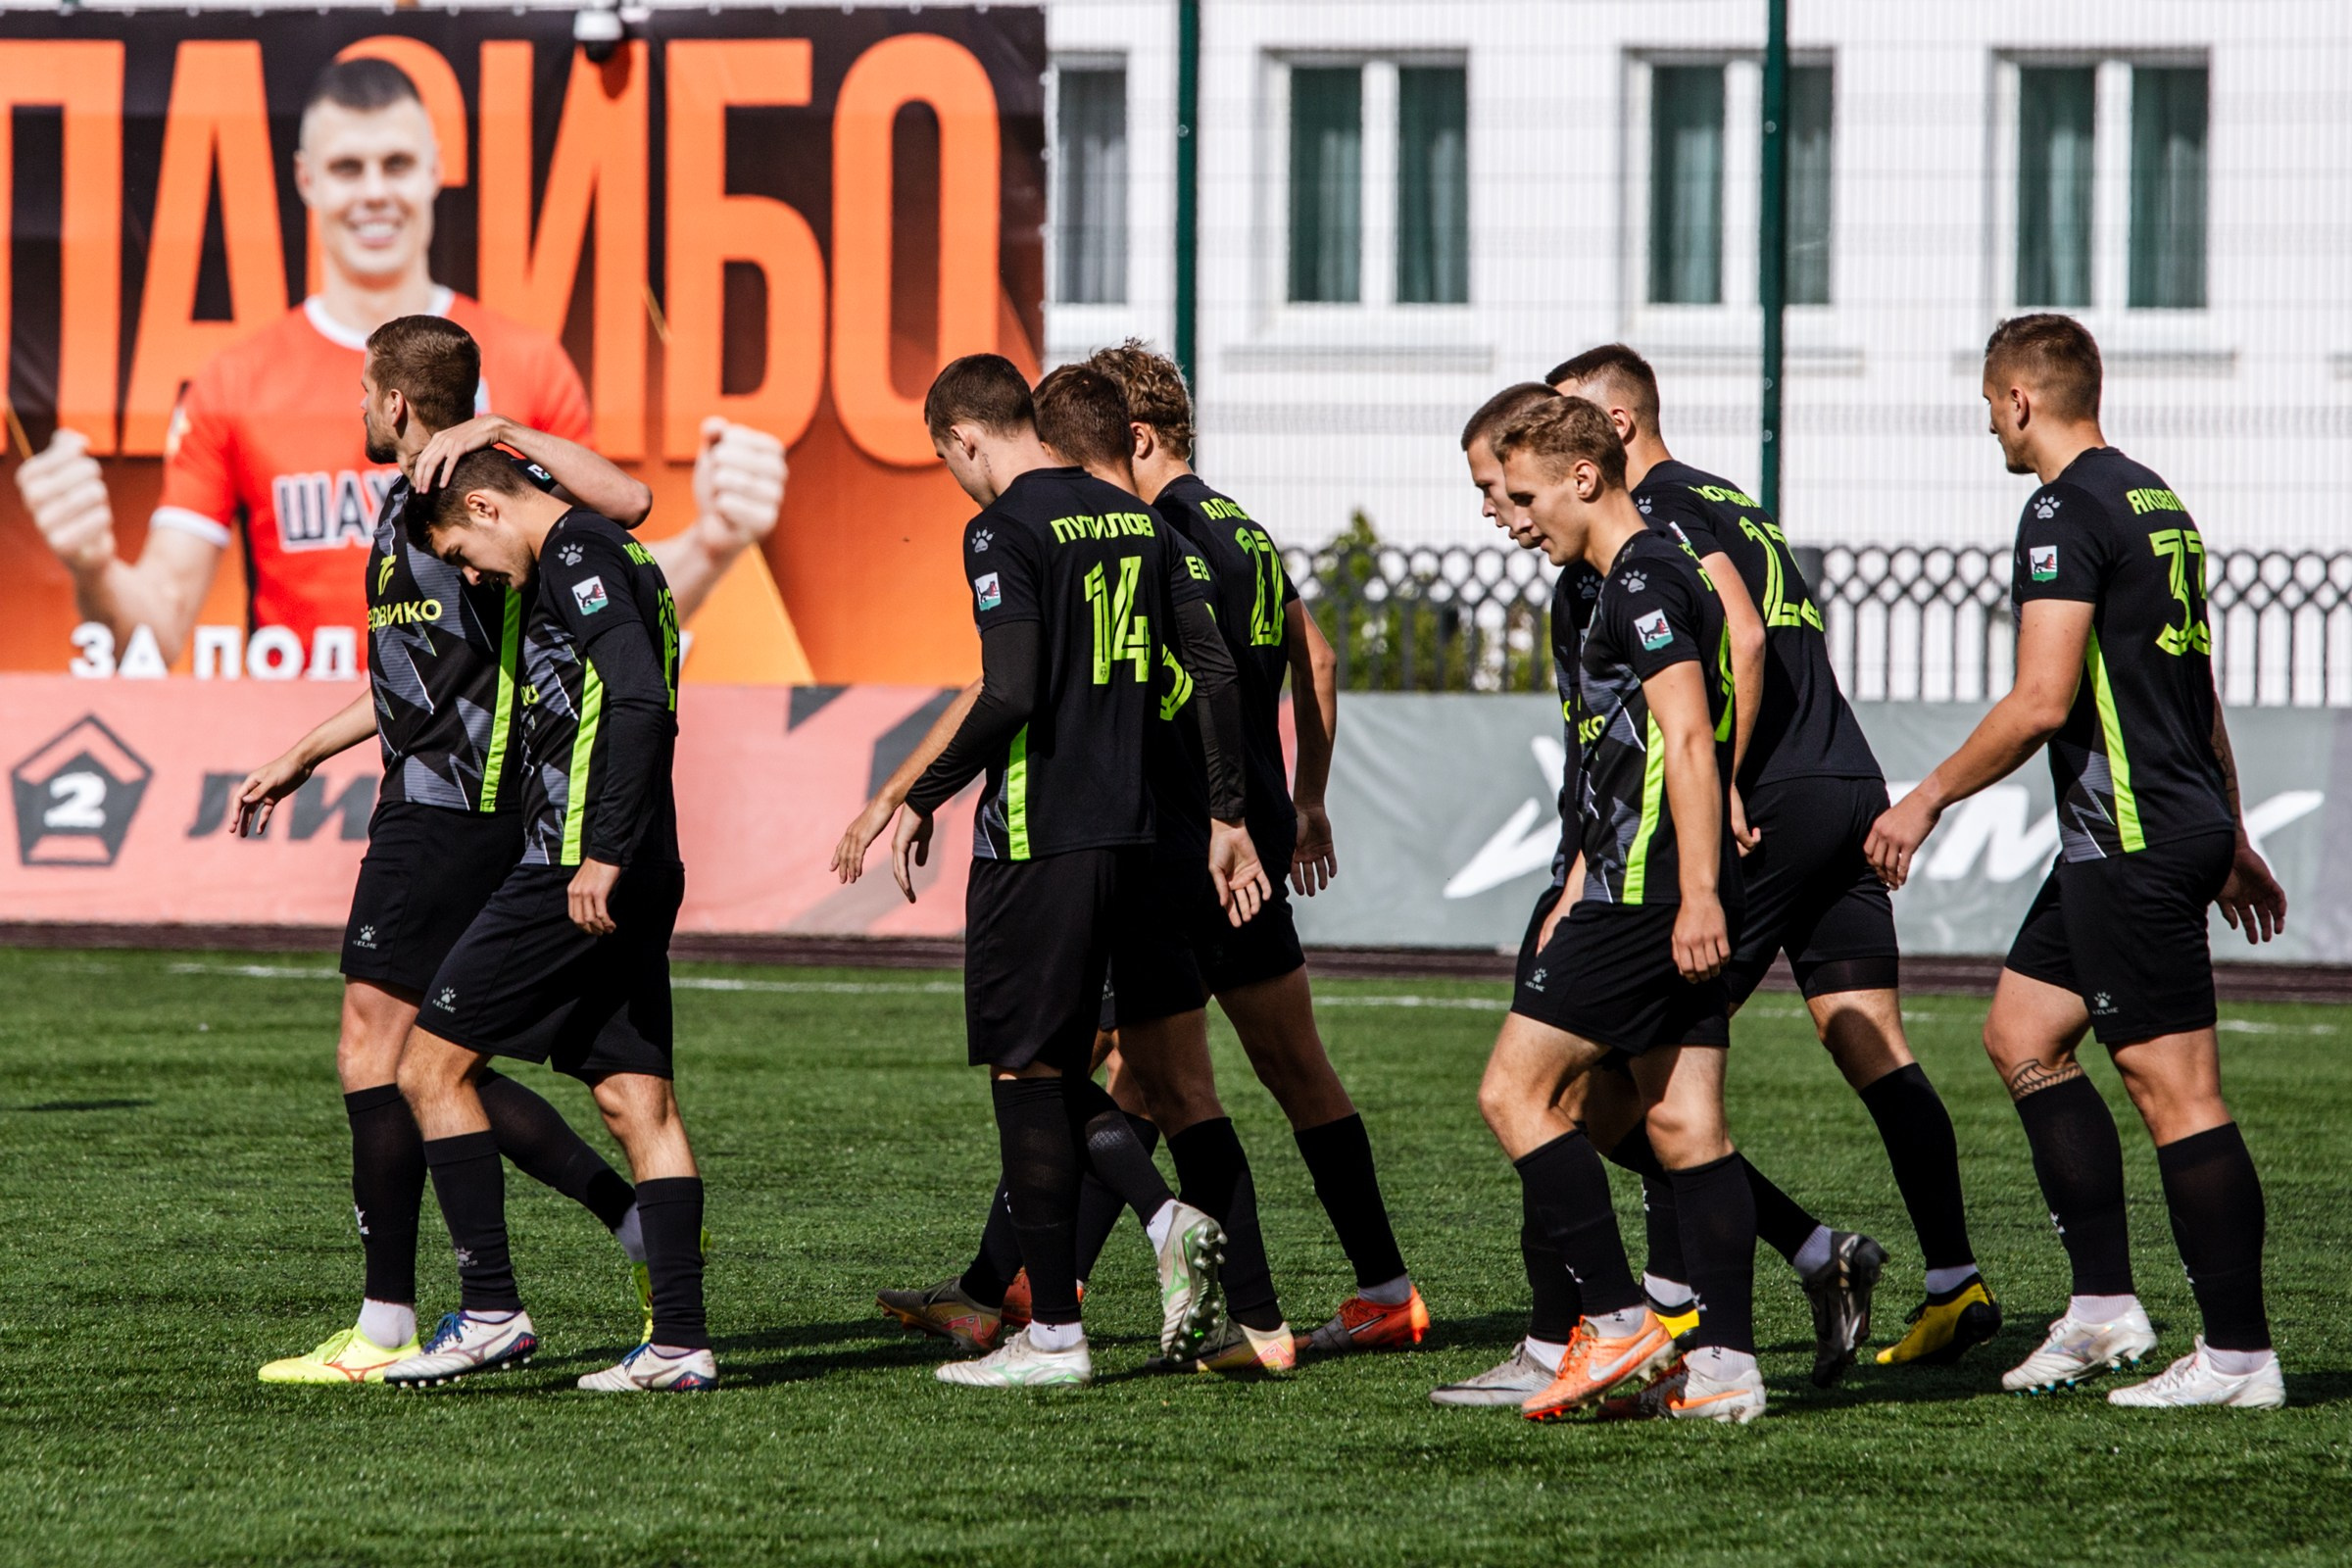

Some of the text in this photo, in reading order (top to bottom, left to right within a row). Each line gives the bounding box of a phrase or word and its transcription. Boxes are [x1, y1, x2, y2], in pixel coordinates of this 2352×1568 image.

[1084, 556, 1151, 685] 14
[70, 622, 168, 679] ЗА
[44, 771, 107, 828] 2
